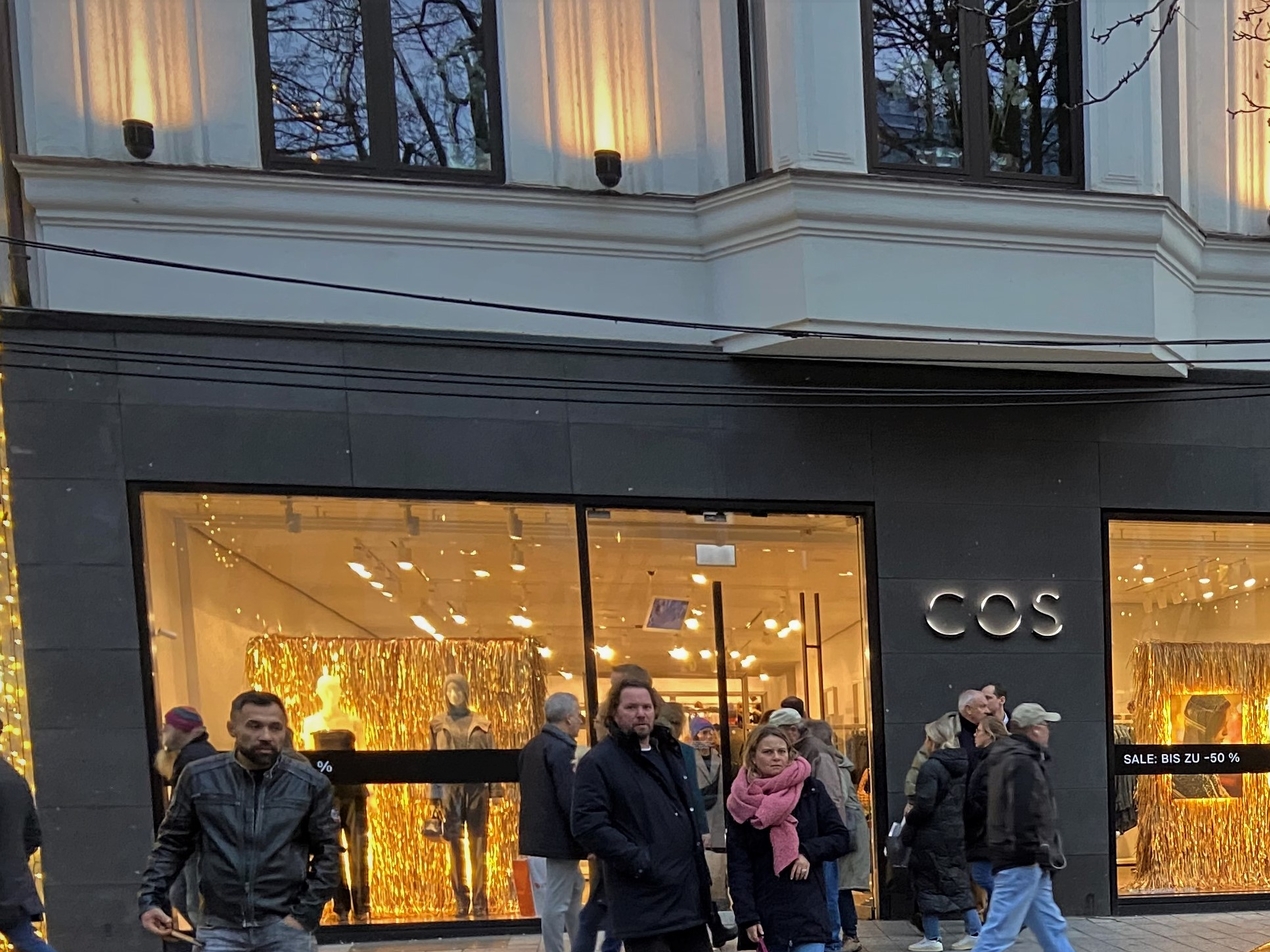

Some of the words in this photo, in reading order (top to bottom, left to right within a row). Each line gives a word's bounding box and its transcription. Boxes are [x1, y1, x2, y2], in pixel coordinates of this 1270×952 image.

[925, 591, 1063, 638] COS
[1123, 754, 1158, 765] SALE:
[1161, 753, 1181, 764] BIS
[1184, 753, 1200, 763] ZU
[1204, 752, 1225, 763] -50
[1228, 752, 1240, 763] %
[316, 760, 333, 772] %
